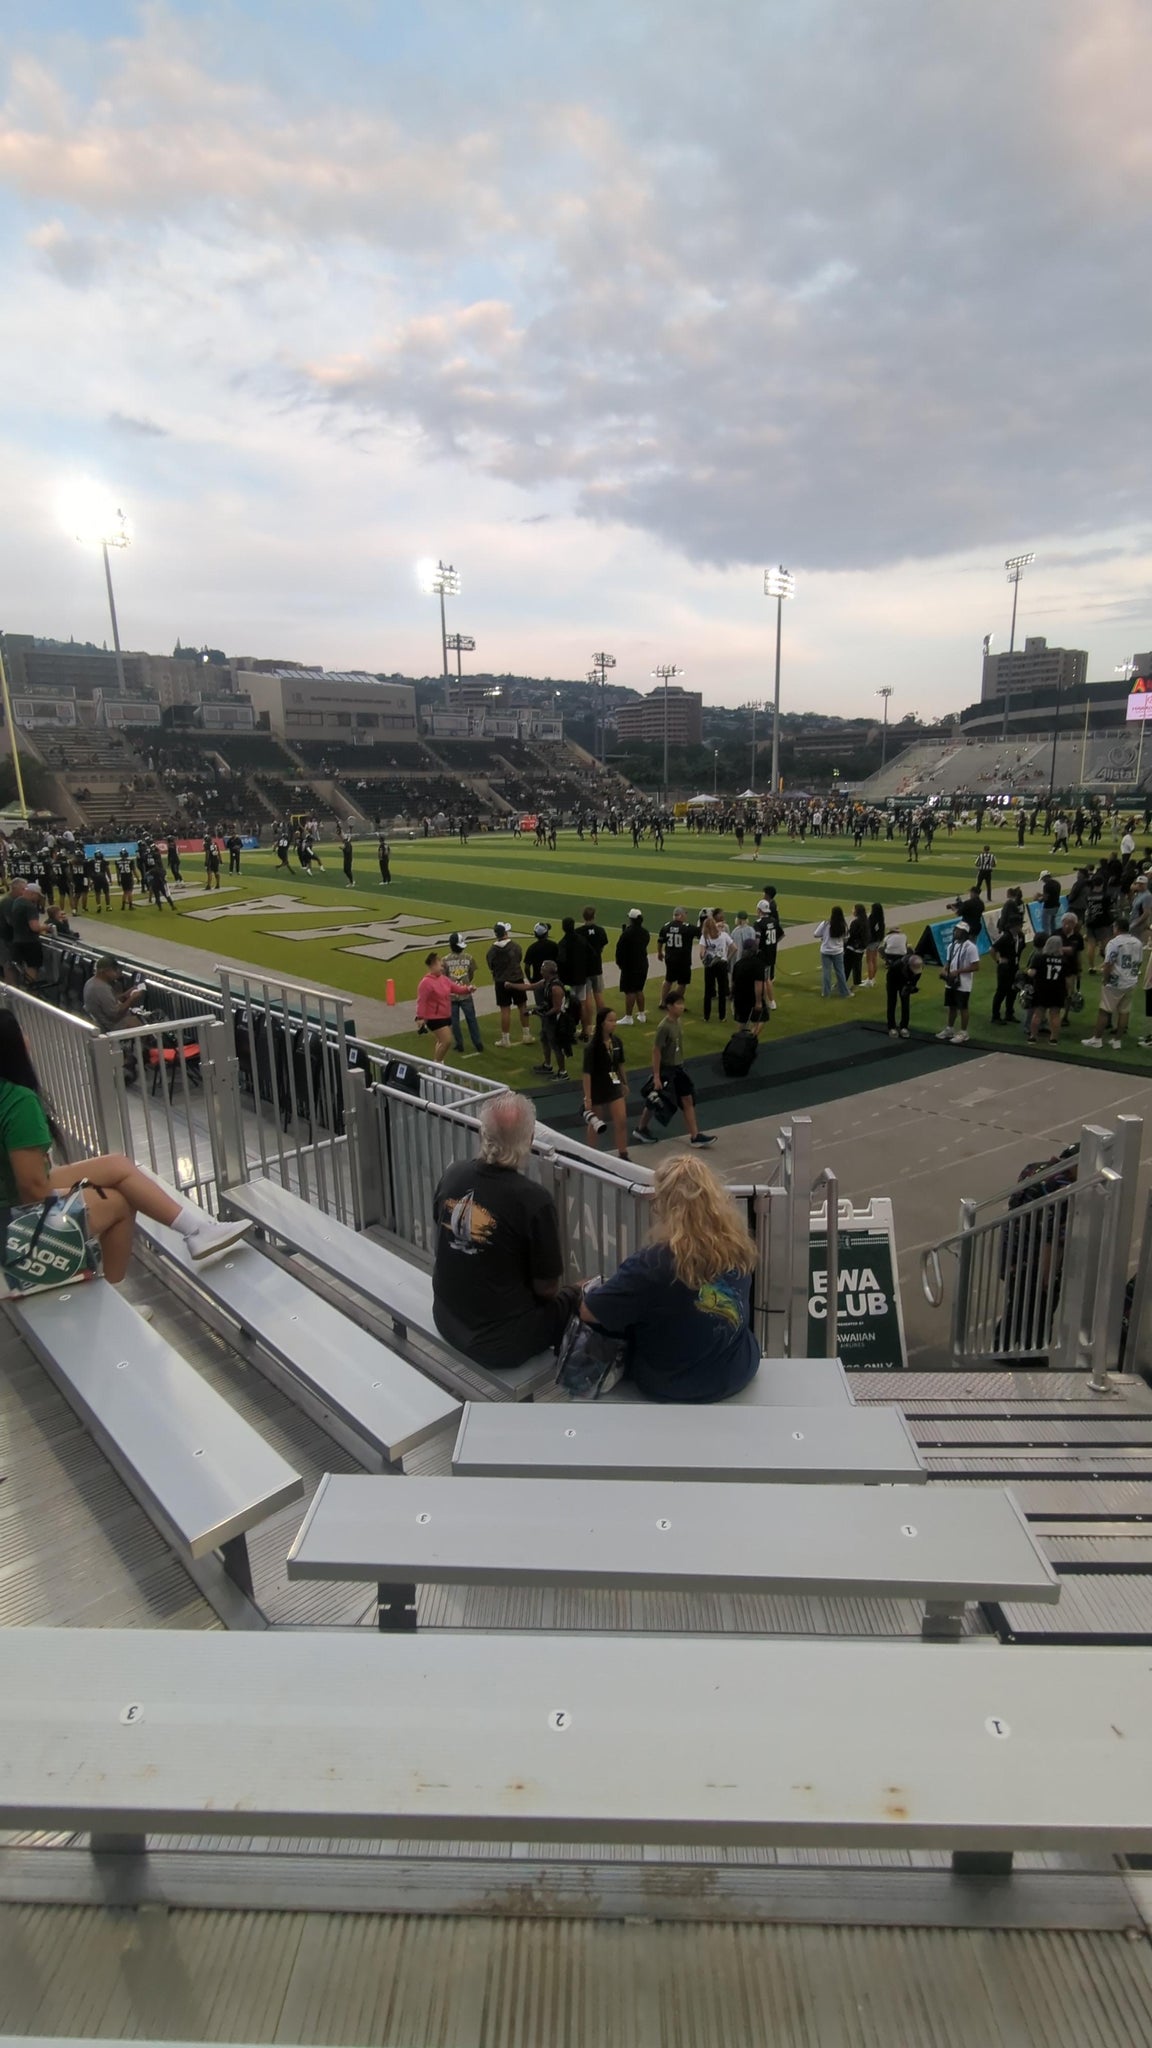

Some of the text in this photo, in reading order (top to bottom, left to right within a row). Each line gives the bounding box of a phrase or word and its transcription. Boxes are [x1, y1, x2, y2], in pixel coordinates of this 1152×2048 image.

[1097, 768, 1143, 779] Allstat
[666, 933, 683, 947] 30
[766, 929, 776, 945] 30
[1046, 964, 1062, 980] 17
[836, 1332, 876, 1342] AWAIIAN
[126, 1705, 139, 1720] 3
[556, 1712, 565, 1727] 2
[991, 1720, 1003, 1735] 1
